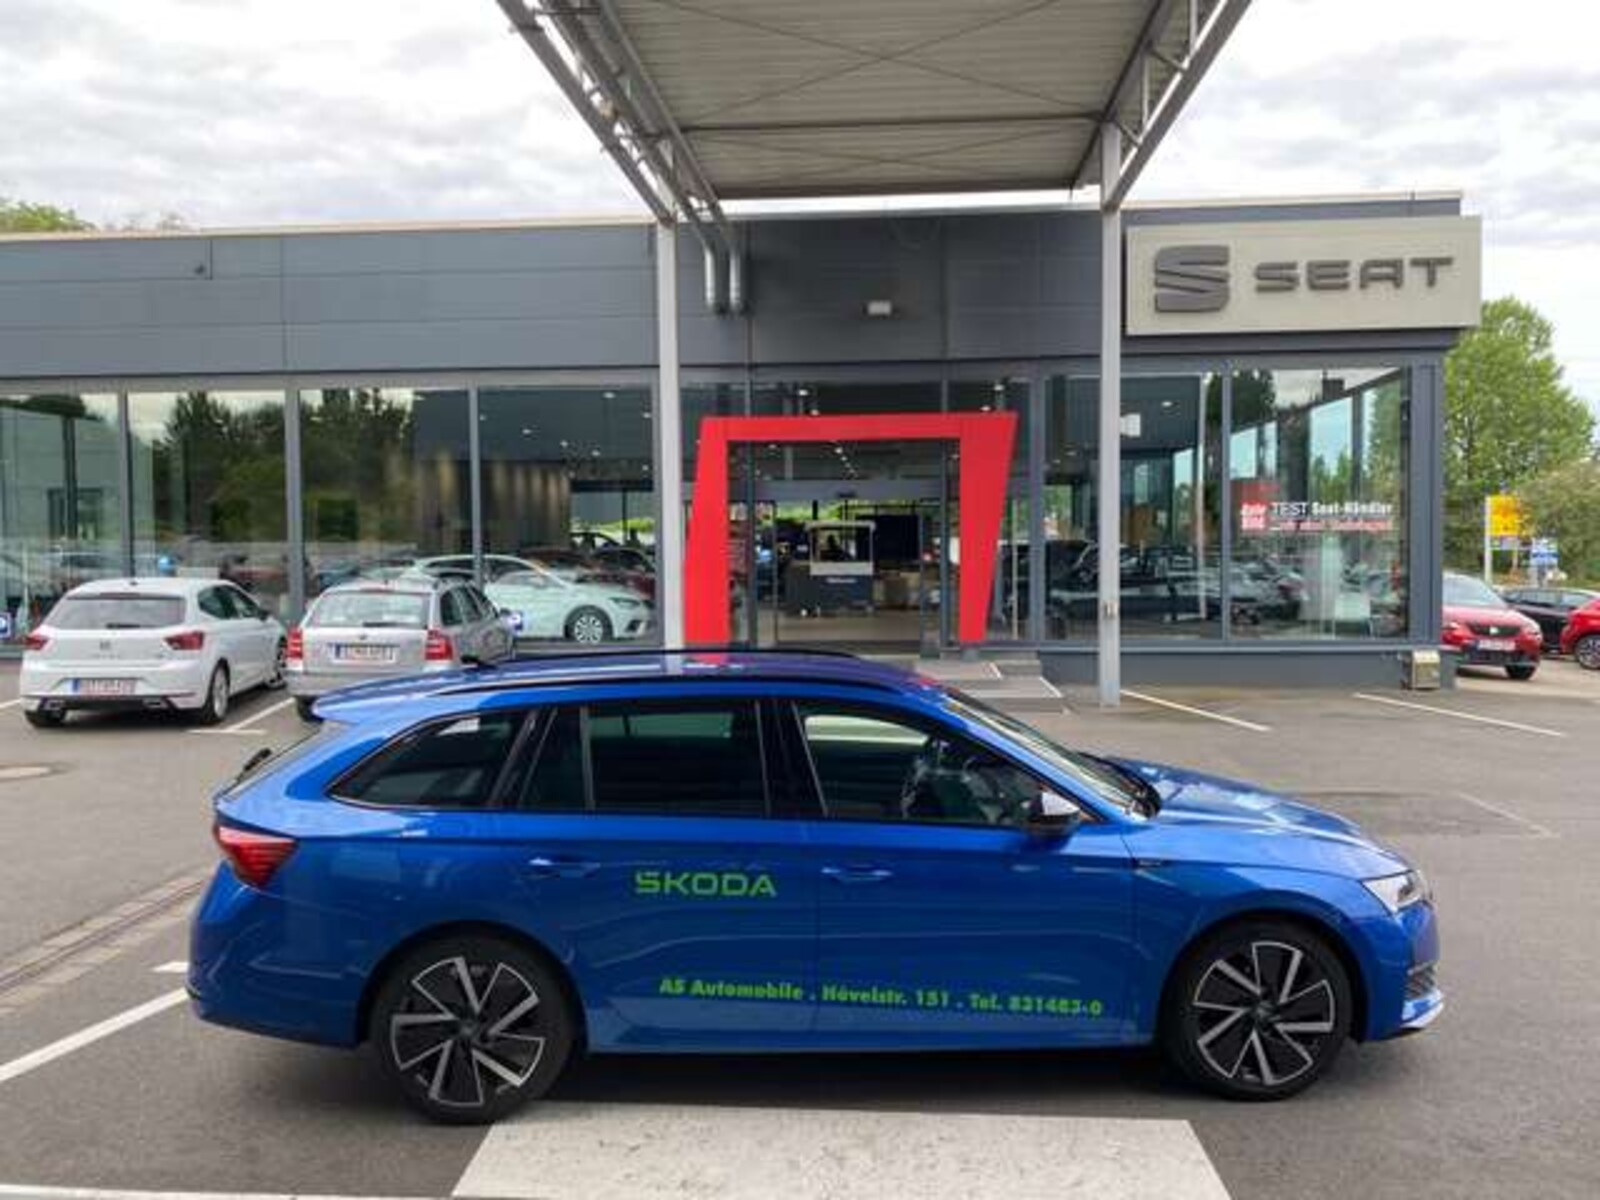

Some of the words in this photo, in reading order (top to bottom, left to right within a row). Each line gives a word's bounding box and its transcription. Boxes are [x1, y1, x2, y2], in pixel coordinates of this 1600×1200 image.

[1254, 256, 1454, 293] SEAT
[659, 977, 685, 995] AS
[688, 978, 803, 1000] Automobile
